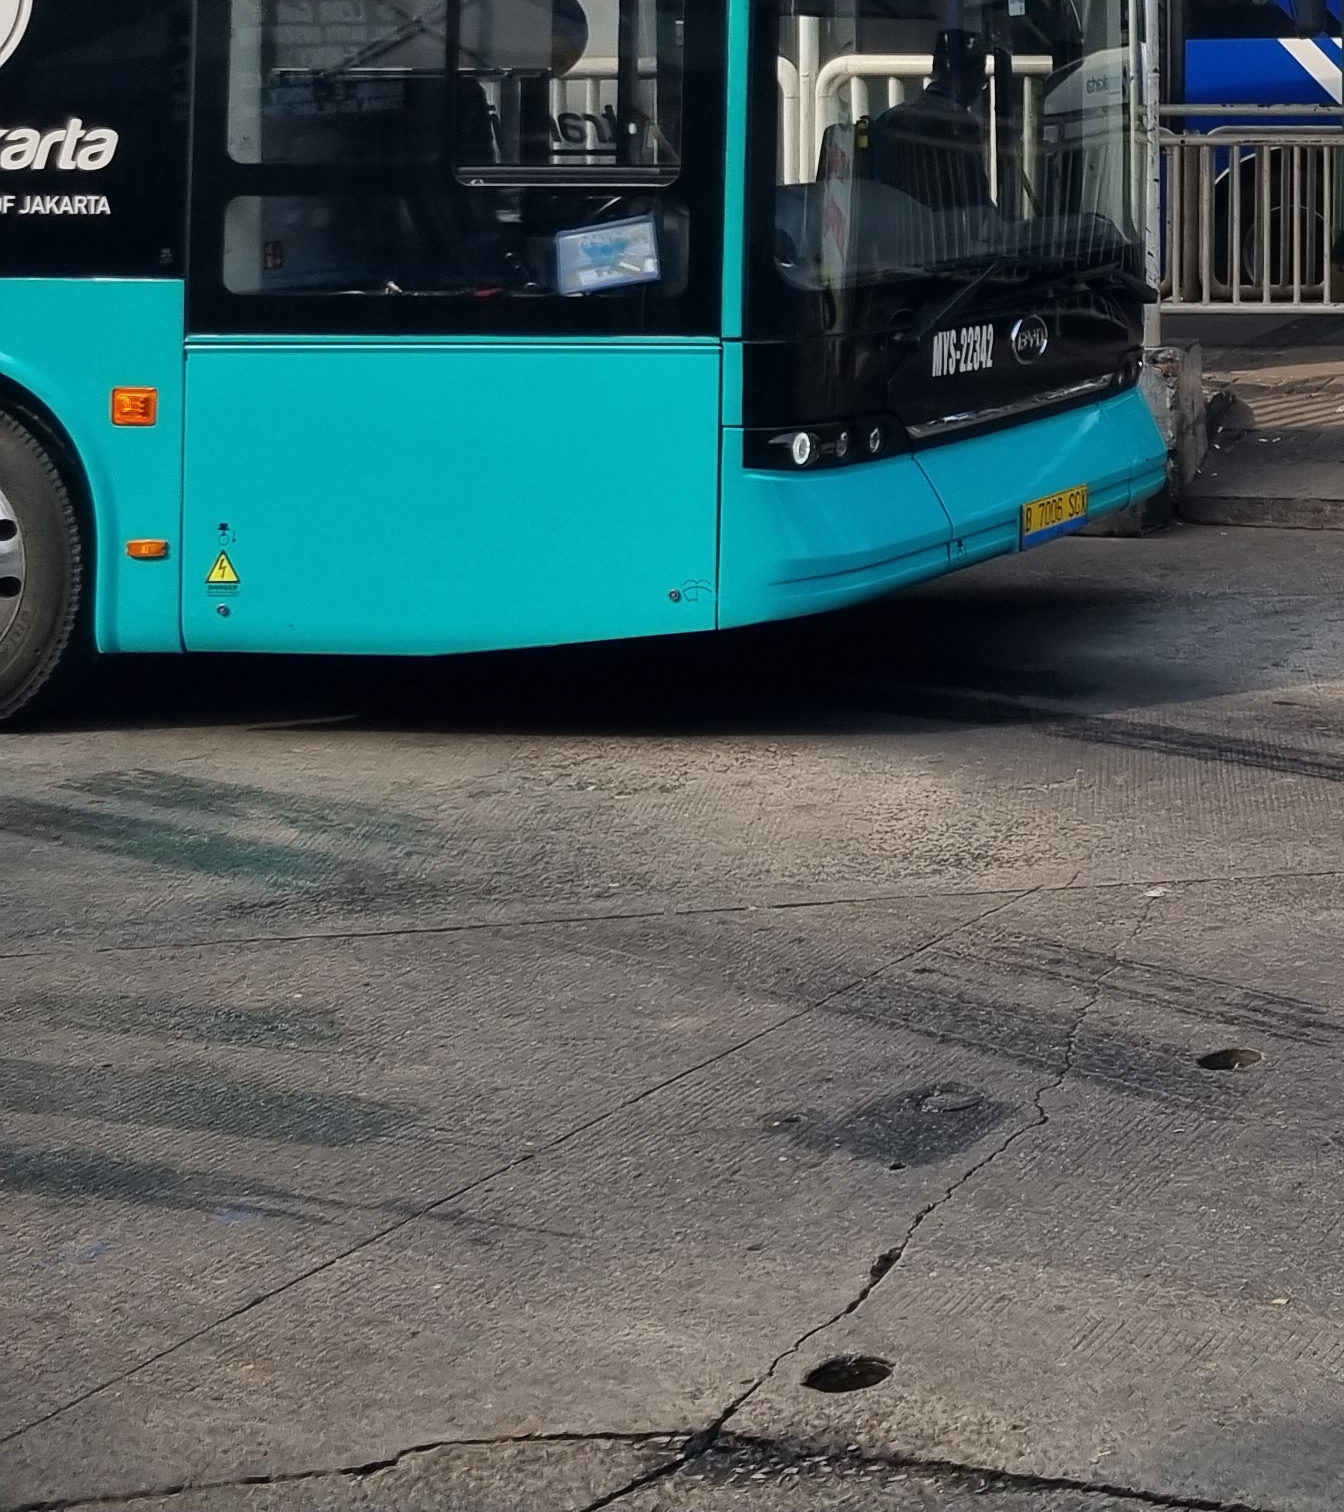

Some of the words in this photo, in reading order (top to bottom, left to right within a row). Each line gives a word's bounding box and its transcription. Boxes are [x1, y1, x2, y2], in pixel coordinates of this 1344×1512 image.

[0, 118, 119, 171] arta
[0, 195, 17, 214] F
[19, 195, 112, 215] JAKARTA
[932, 324, 994, 377] MYS-22342
[1025, 506, 1033, 533] B
[1039, 497, 1063, 528] 7006
